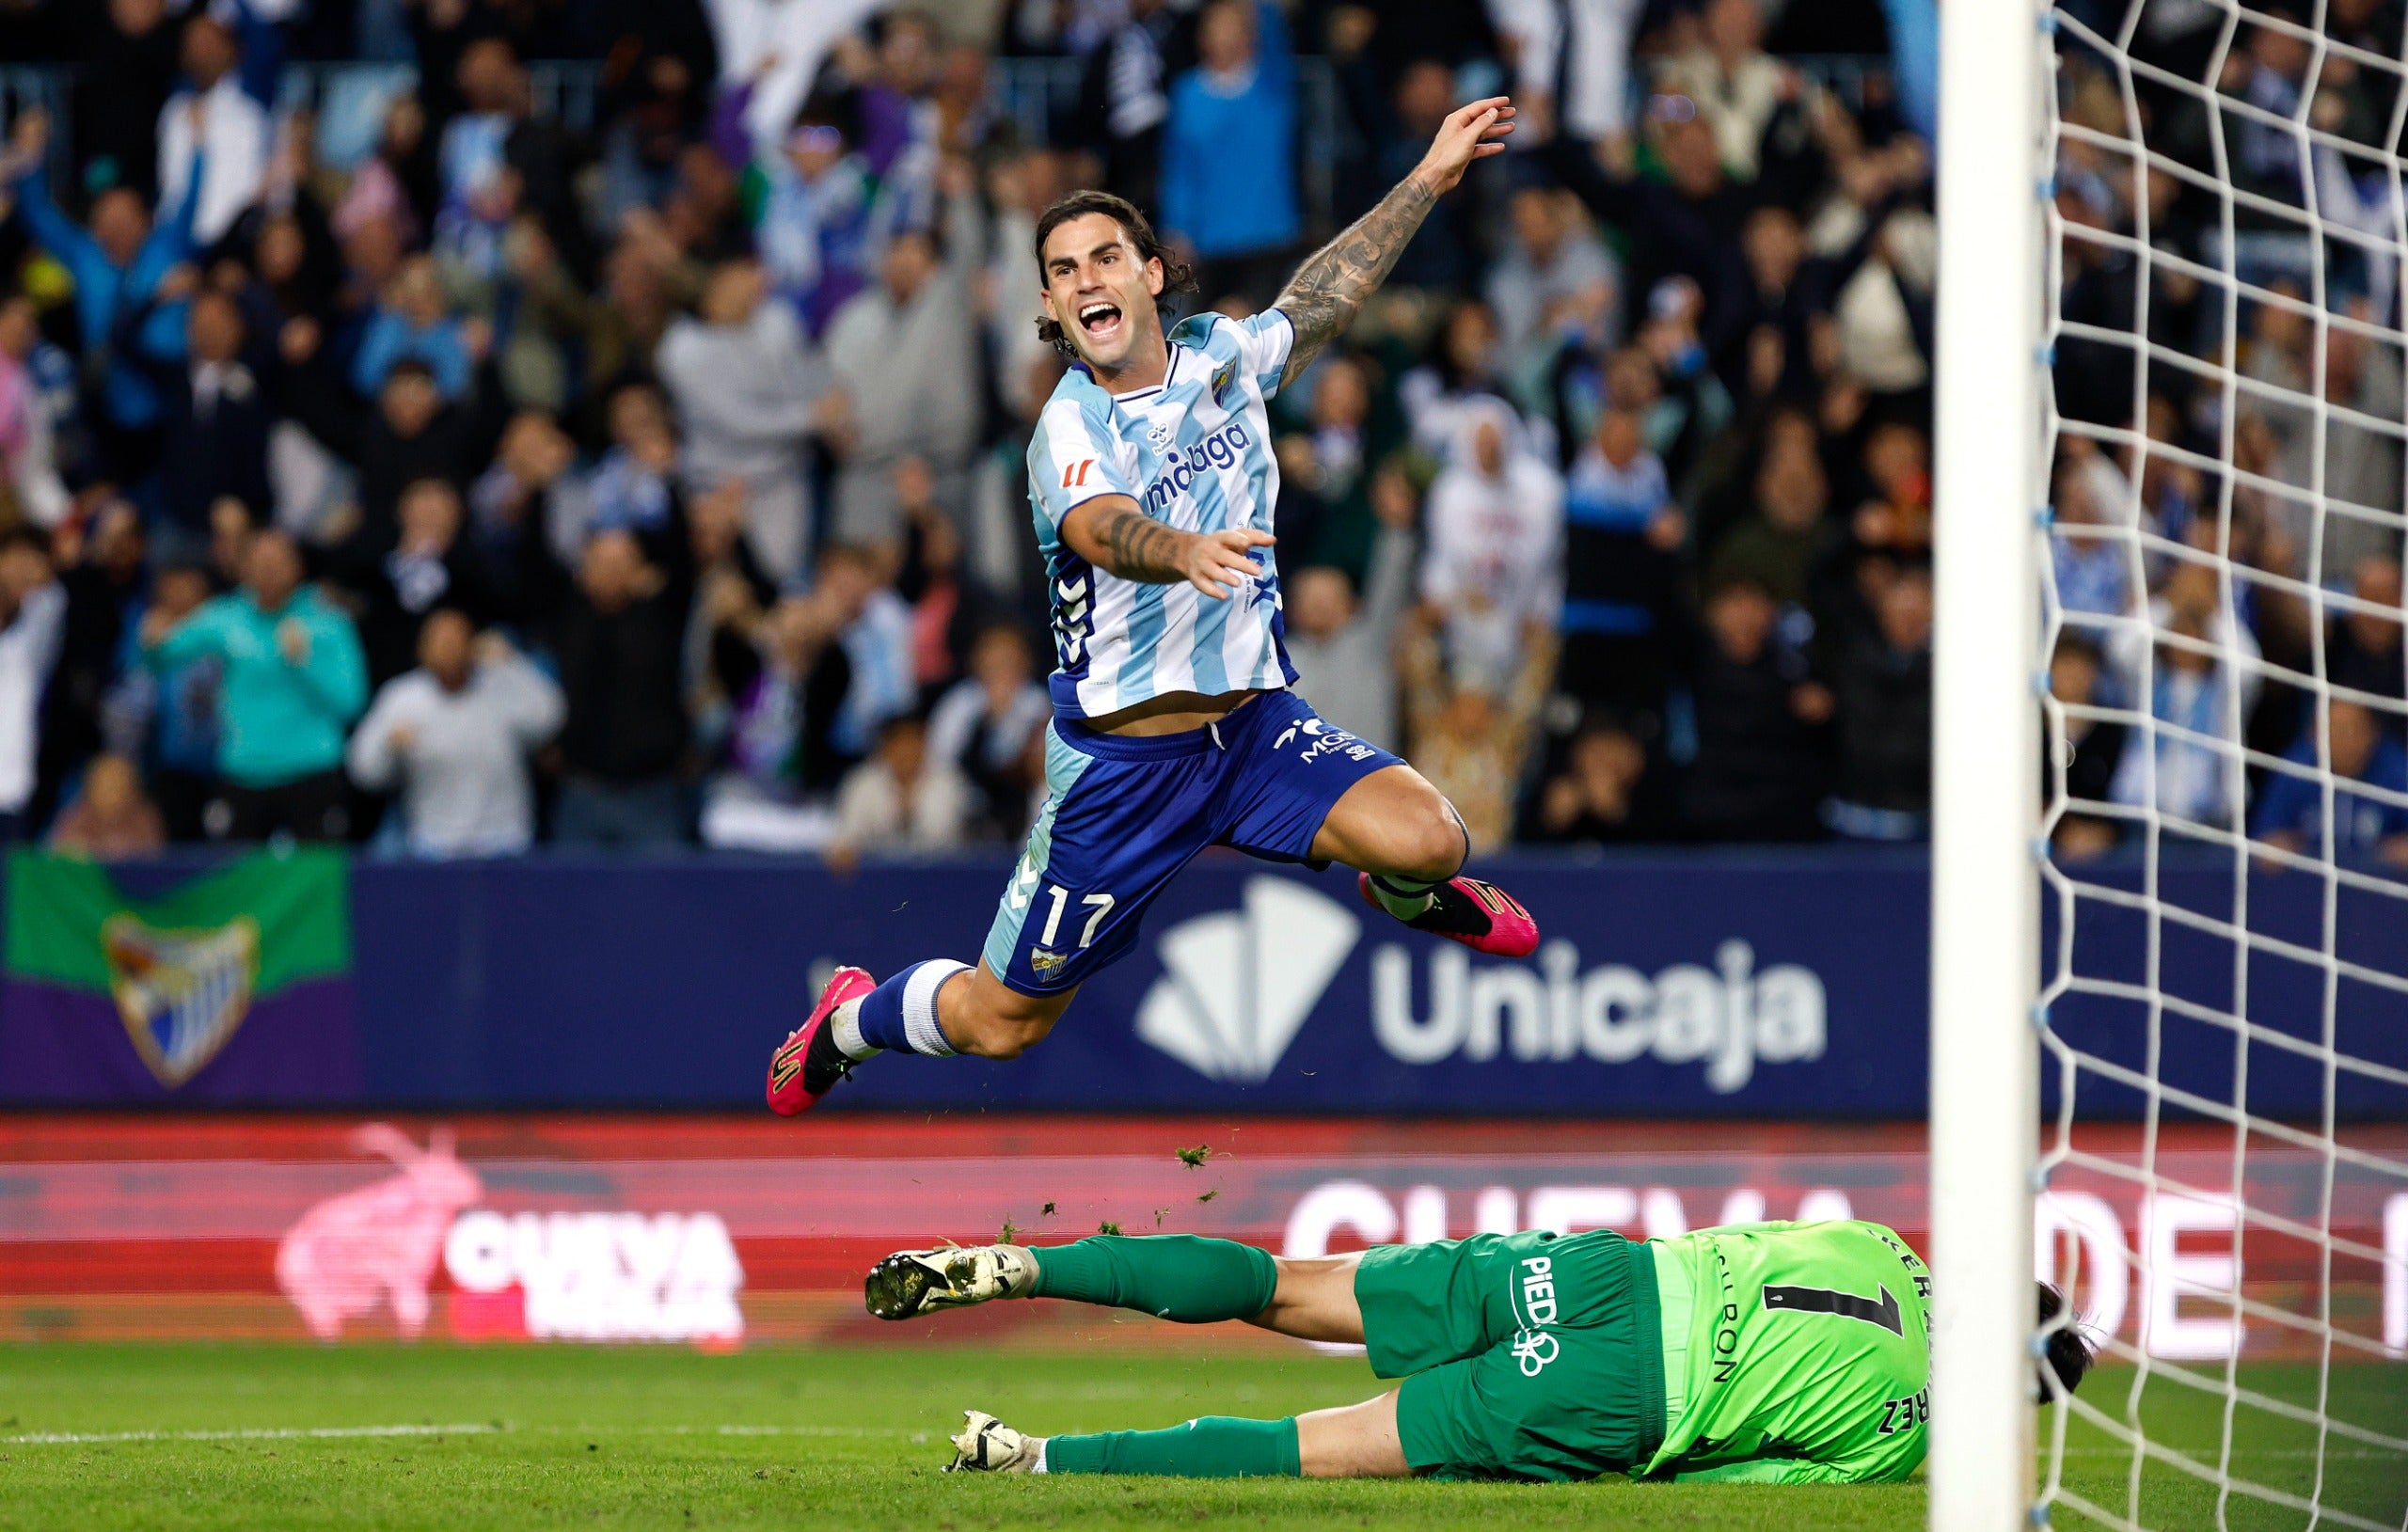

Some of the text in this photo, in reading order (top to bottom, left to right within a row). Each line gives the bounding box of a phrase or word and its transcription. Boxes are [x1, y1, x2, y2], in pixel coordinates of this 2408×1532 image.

[1040, 884, 1116, 948] 17
[1372, 938, 1828, 1095] Unicaja
[1762, 1282, 1905, 1339] 1
